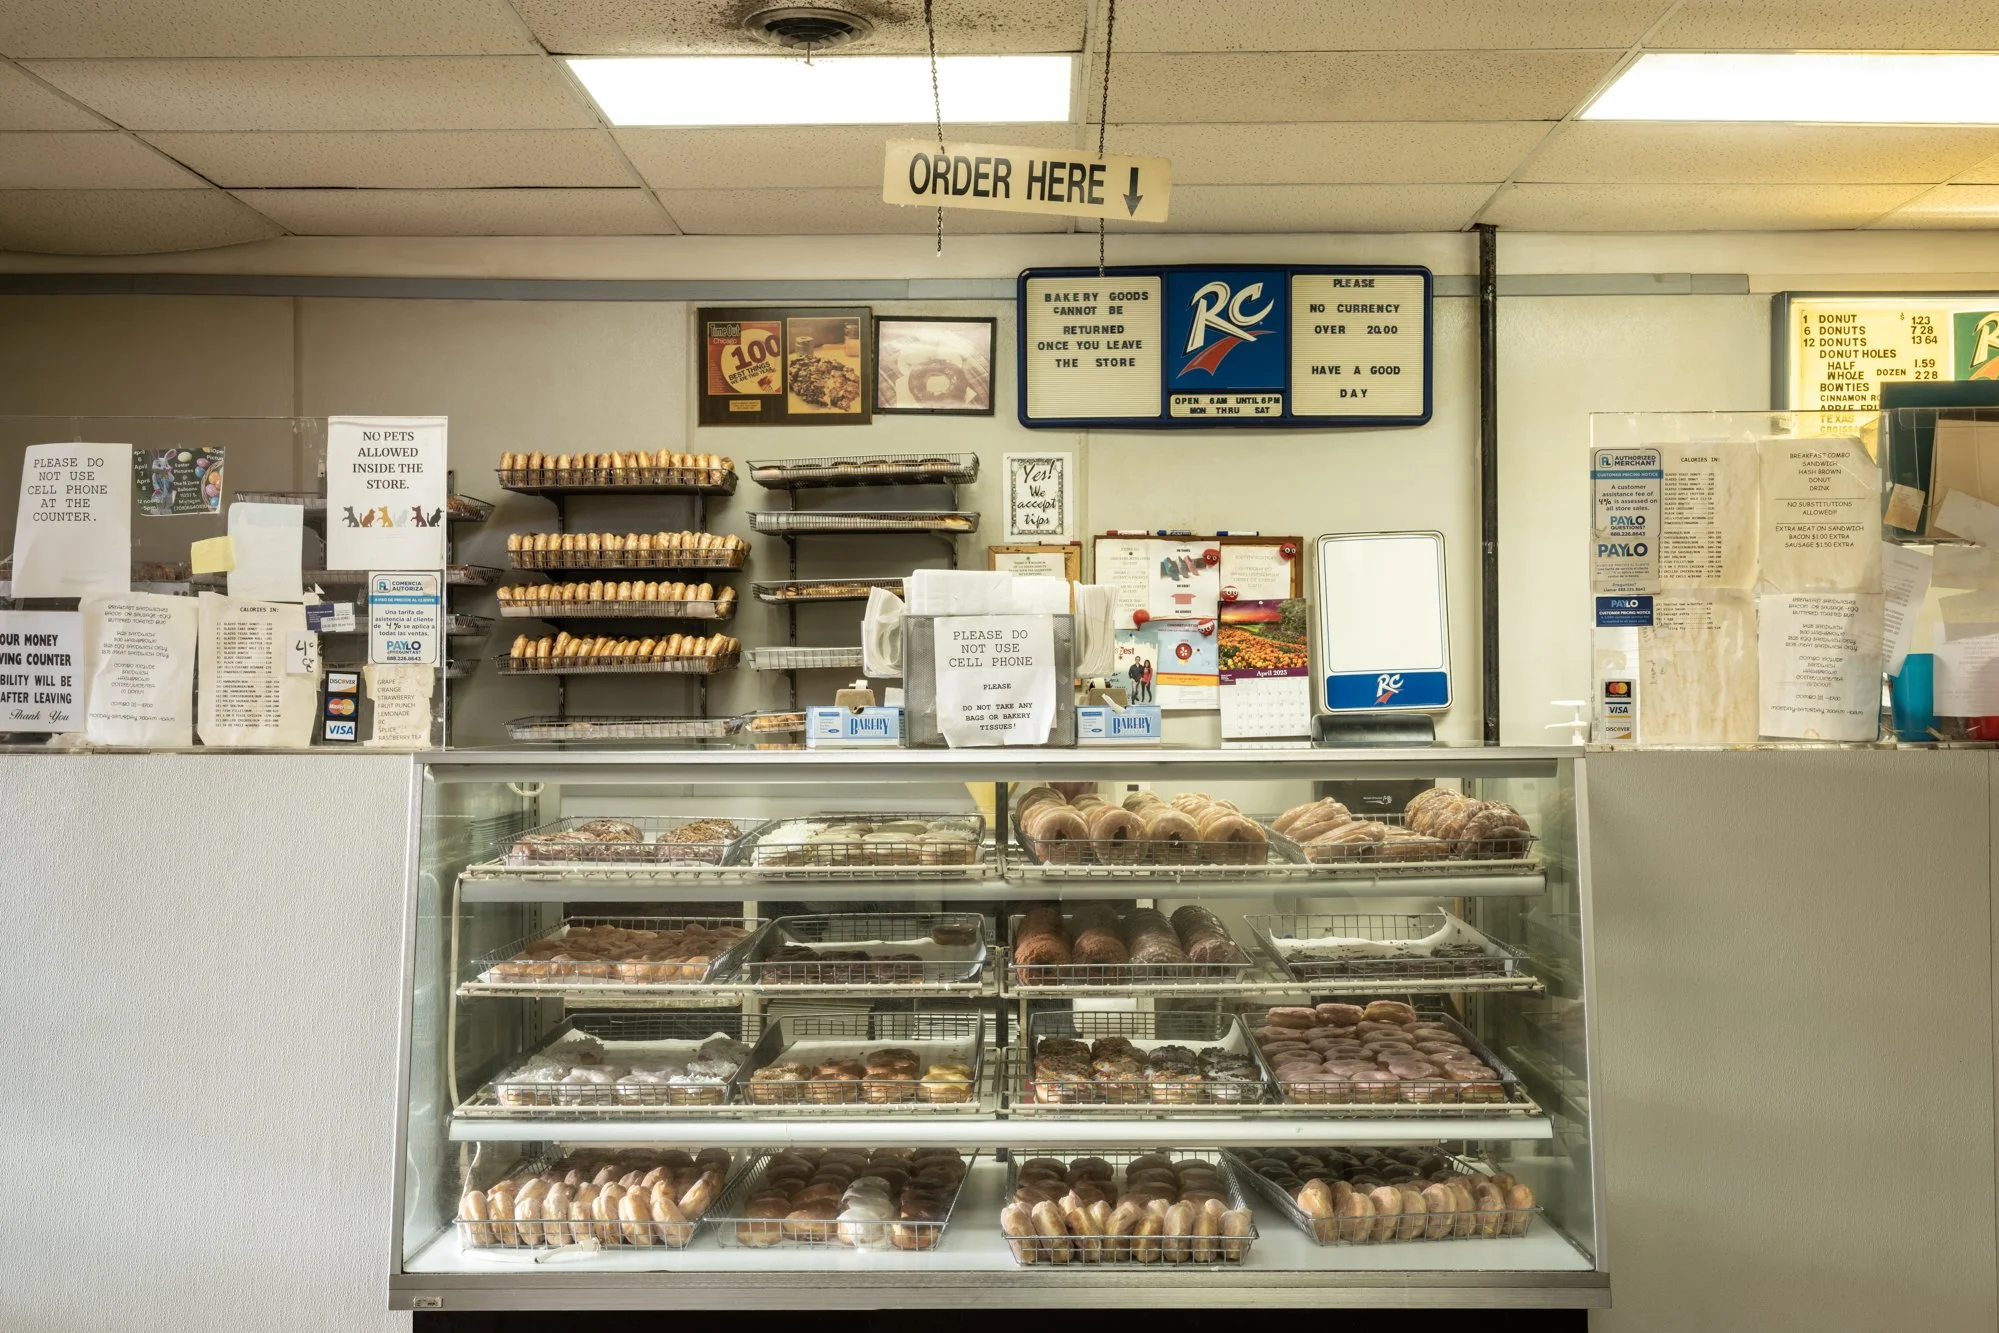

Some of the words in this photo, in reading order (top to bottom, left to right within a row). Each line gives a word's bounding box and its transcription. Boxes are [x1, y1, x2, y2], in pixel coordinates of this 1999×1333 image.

[909, 153, 1011, 199] ORDER
[1027, 160, 1106, 205] HERE
[1333, 279, 1375, 288] PLEASE
[1044, 293, 1099, 302] BAKERY
[1109, 292, 1149, 301] GOODS
[1053, 306, 1097, 315] CANNOT
[1109, 306, 1123, 315] BE
[1309, 304, 1325, 313] NO
[1337, 304, 1400, 313] CURRENCY
[1181, 281, 1275, 357] RC
[1803, 315, 1808, 324] 1
[1818, 314, 1857, 324] DONUT
[1911, 316, 1931, 325] 1.23
[1063, 325, 1125, 335] RETURNED
[1314, 325, 1346, 334] OVER
[1804, 326, 1811, 335] 6
[1819, 326, 1866, 335] DONUTS
[713, 337, 738, 345] Chicago
[1037, 341, 1069, 351] ONCE
[1076, 341, 1099, 350] YOU
[1107, 340, 1142, 350] LEAVE
[1803, 338, 1815, 347] 12
[1819, 338, 1867, 347] DONUTS
[731, 334, 781, 371] 100
[1819, 350, 1859, 359] DONUT
[1862, 349, 1897, 358] HOLES
[1055, 358, 1078, 368] THE
[1095, 358, 1135, 367] STORE
[1827, 361, 1855, 370] HALF
[1914, 359, 1936, 368] 1.59
[728, 368, 747, 381] BEST
[747, 361, 771, 375] THINGS
[1312, 366, 1341, 375] HAVE
[1353, 366, 1361, 375] A
[1370, 365, 1400, 375] GOOD
[1827, 371, 1864, 380] WHOLE
[1820, 382, 1869, 392] BOWTIES
[1340, 389, 1368, 398] DAY
[1175, 397, 1199, 405] OPEN
[1236, 396, 1259, 404] UNTIL
[1254, 406, 1270, 414] SAT
[363, 431, 380, 441] NO
[384, 431, 415, 441] PETS
[357, 447, 419, 458] ALLOWED
[33, 458, 78, 468] PLEASE
[87, 458, 104, 467] DO
[353, 463, 395, 473] INSIDE
[398, 463, 423, 473] THE
[39, 471, 61, 481] NOT
[70, 471, 95, 481] USE
[1023, 460, 1055, 483] Yes!
[366, 479, 410, 490] STORE.
[27, 485, 57, 495] CELL
[66, 485, 108, 494] PHONE
[1029, 485, 1046, 498] We
[40, 499, 56, 508] AT
[66, 498, 91, 508] THE
[1017, 498, 1056, 513] accept
[33, 512, 97, 522] COUNTER.
[1024, 513, 1050, 528] tips
[1609, 515, 1646, 526] PAYLO
[1597, 542, 1648, 558] PAYLO
[1611, 599, 1639, 608] PAYLO
[0, 634, 20, 646] OUR
[24, 634, 58, 646] MONEY
[953, 630, 1003, 641] PLEASE
[1011, 629, 1028, 640] DO
[386, 640, 422, 651] PAYLO
[961, 644, 986, 654] NOT
[995, 643, 1020, 653] USE
[26, 653, 72, 666] COUNTER
[949, 657, 983, 668] CELL
[992, 656, 1033, 667] PHONE
[0, 675, 29, 686] BILITY
[34, 675, 56, 686] WILL
[61, 676, 72, 687] BE
[1376, 673, 1404, 697] RC
[0, 692, 29, 703] AFTER
[34, 693, 72, 704] LEAVING
[1608, 706, 1629, 714] VISA
[9, 709, 41, 720] Thank
[48, 710, 69, 724] You
[965, 714, 985, 722] BAGS
[329, 726, 354, 735] VISA
[850, 718, 889, 735] BAKERY
[979, 723, 1016, 731] TISSUES!
[1112, 717, 1152, 734] BAKERY
